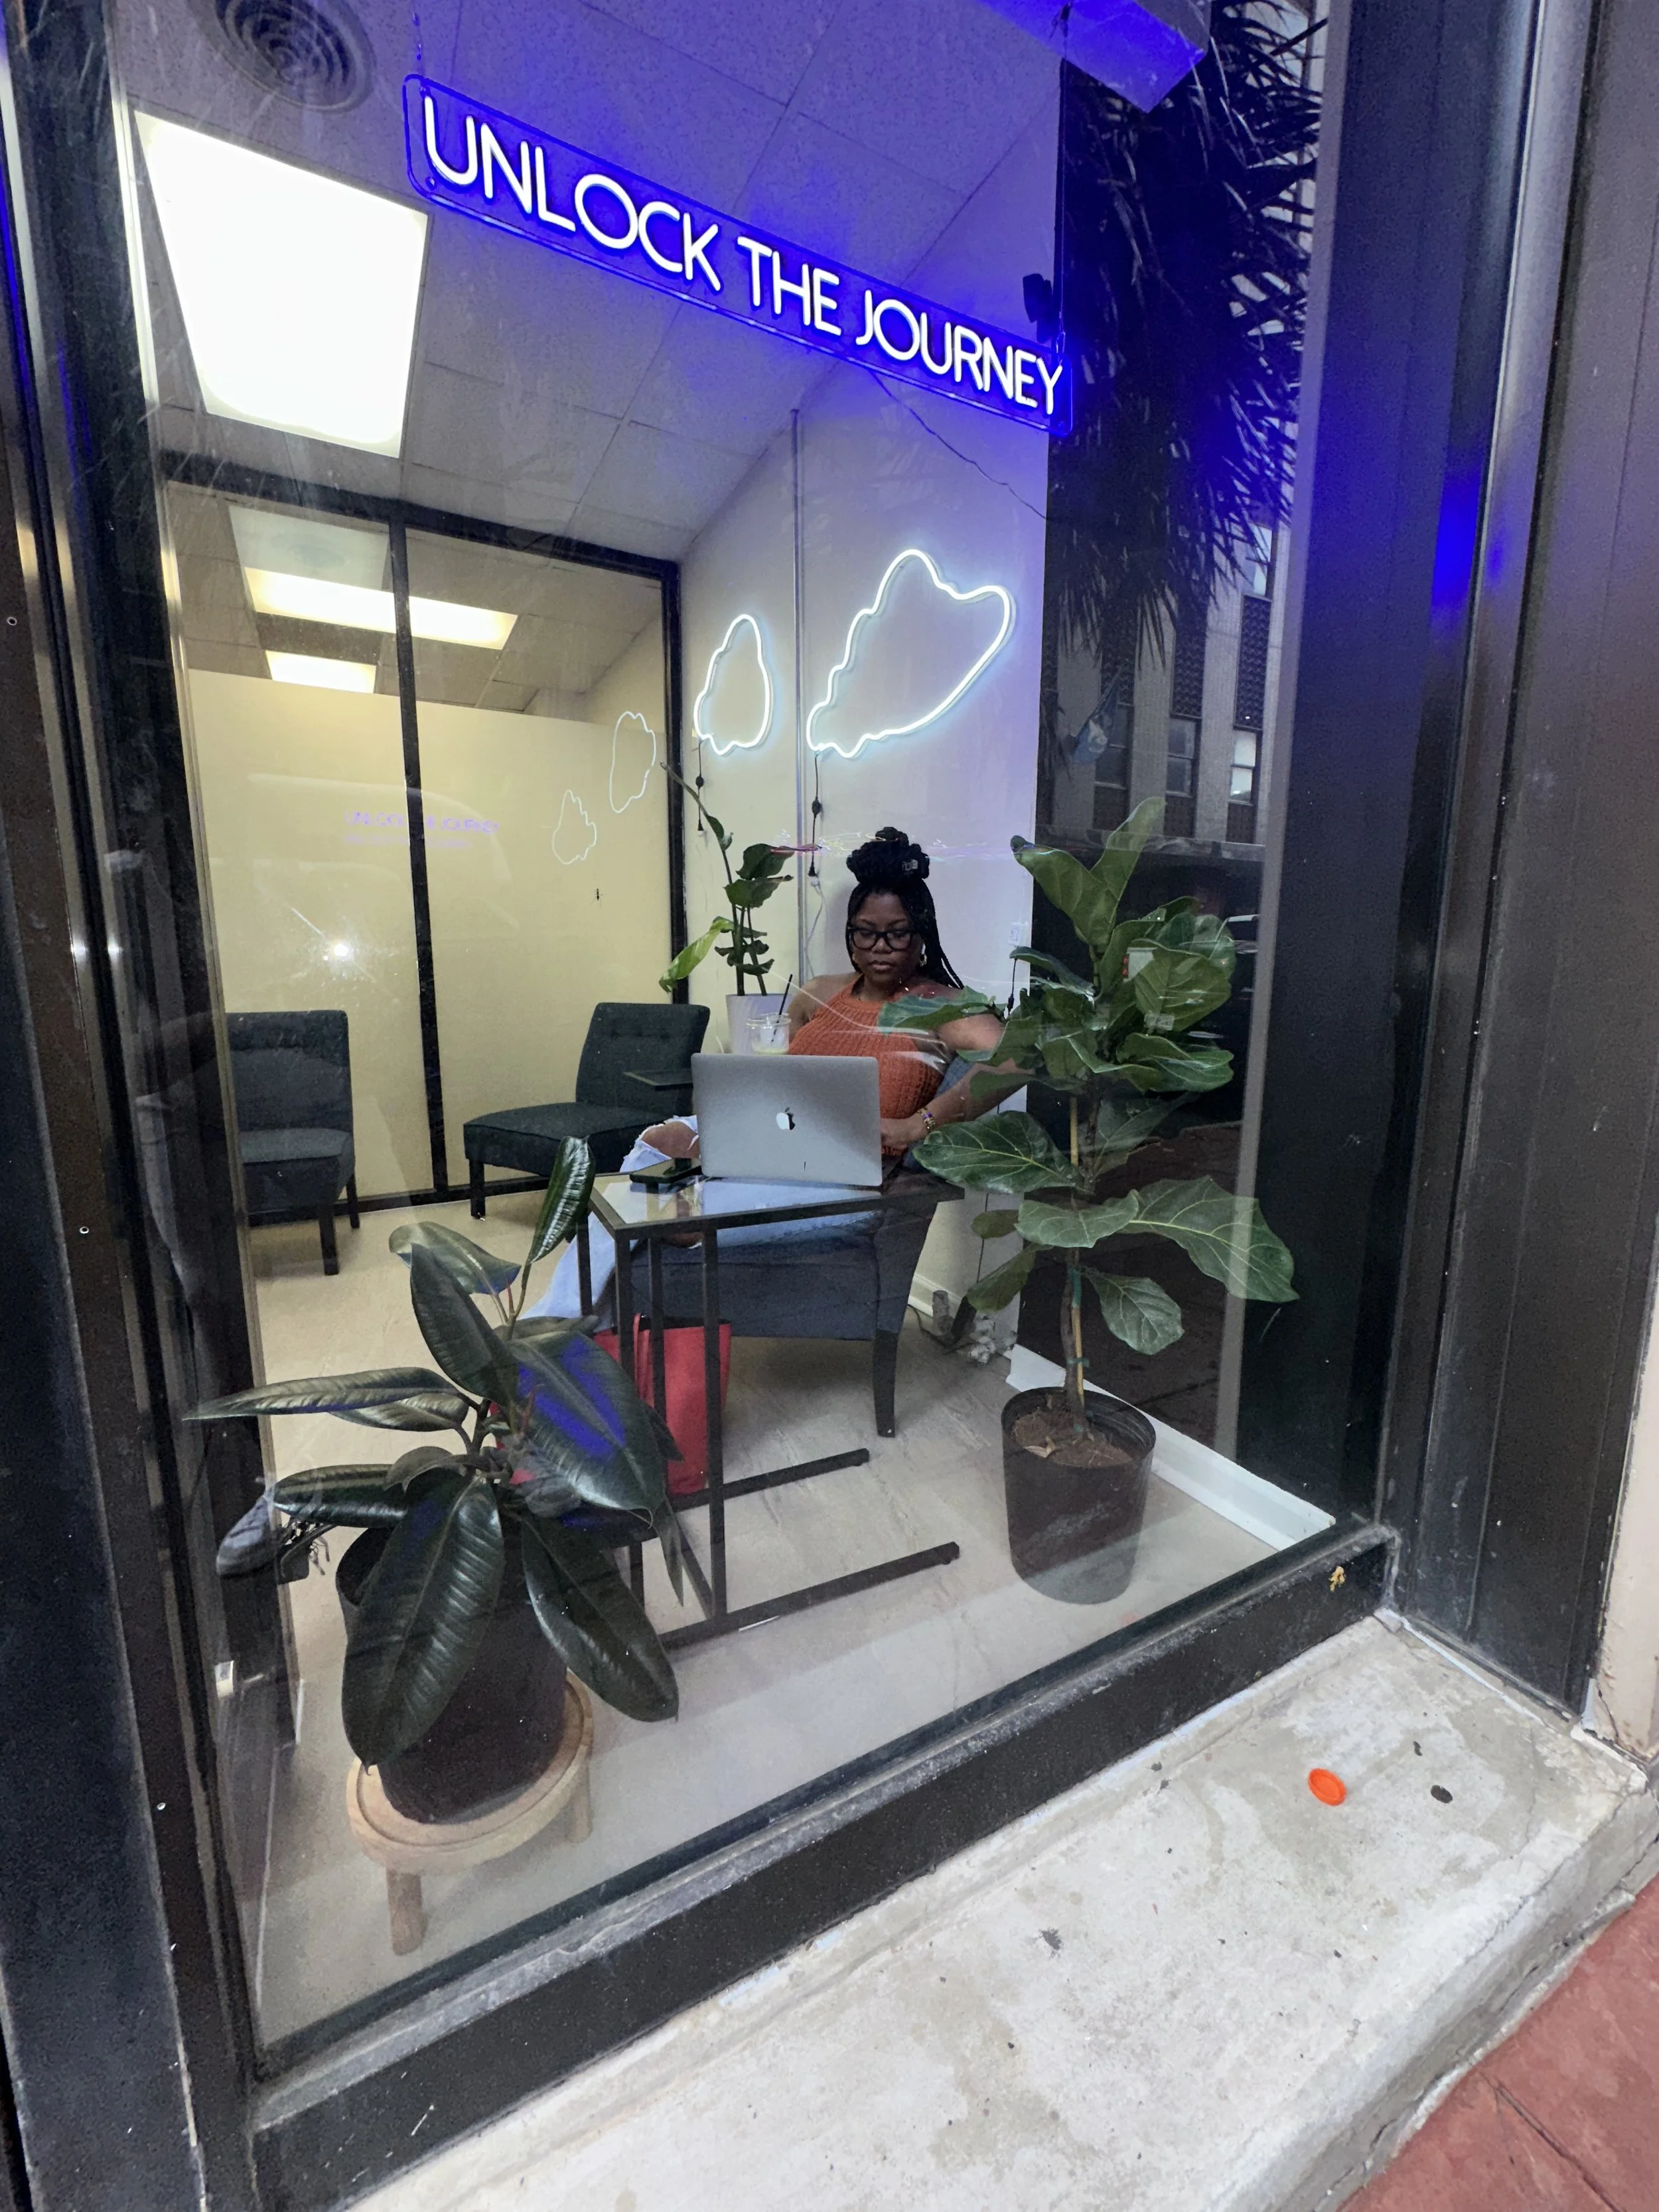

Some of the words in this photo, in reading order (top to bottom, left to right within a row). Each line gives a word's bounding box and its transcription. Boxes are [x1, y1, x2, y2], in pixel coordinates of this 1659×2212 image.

[424, 96, 721, 291] UNLOCK
[737, 236, 841, 336] THE
[855, 289, 1063, 415] JOURNEY
